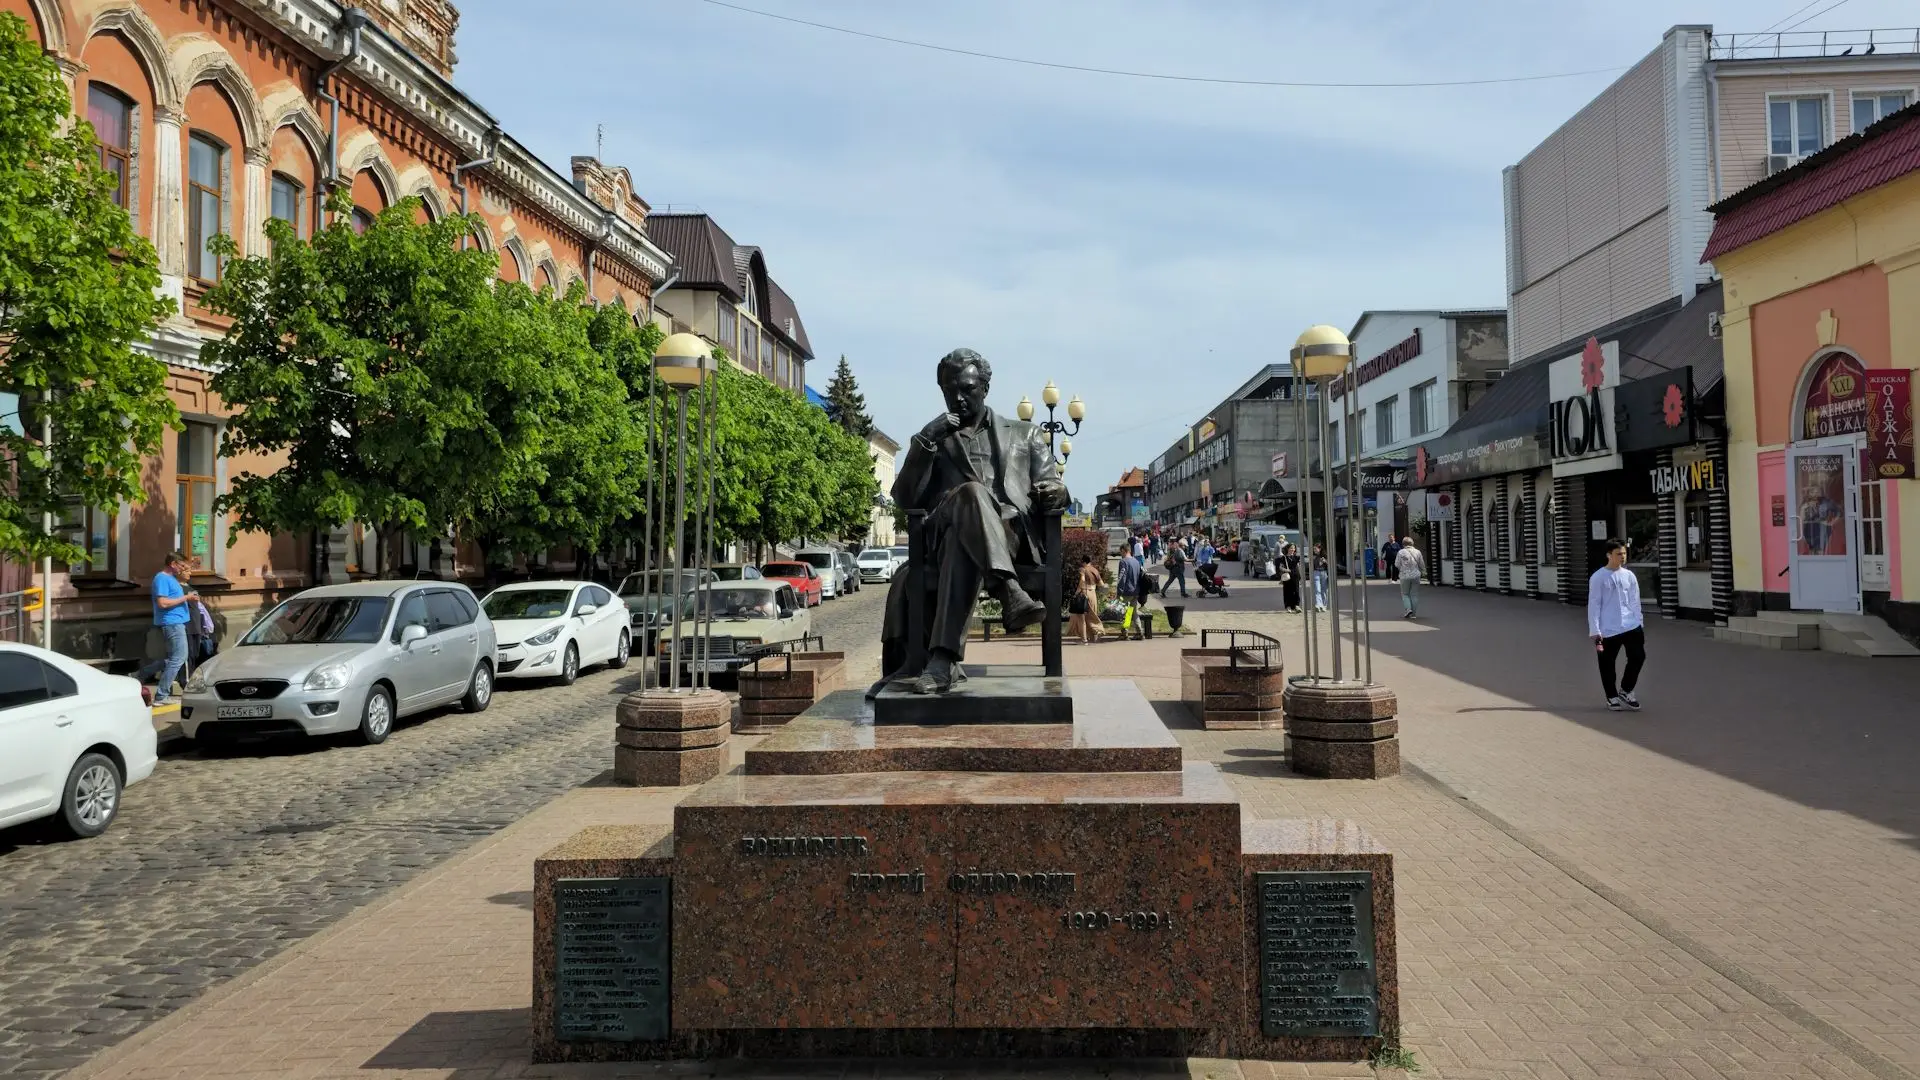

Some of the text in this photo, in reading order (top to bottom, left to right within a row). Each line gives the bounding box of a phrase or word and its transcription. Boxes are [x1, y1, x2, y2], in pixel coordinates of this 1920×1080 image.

[1832, 378, 1853, 393] XXL
[1882, 384, 1899, 459] ОДЕЖДА
[1649, 465, 1690, 494] ТАБАК
[1882, 464, 1901, 473] XXL
